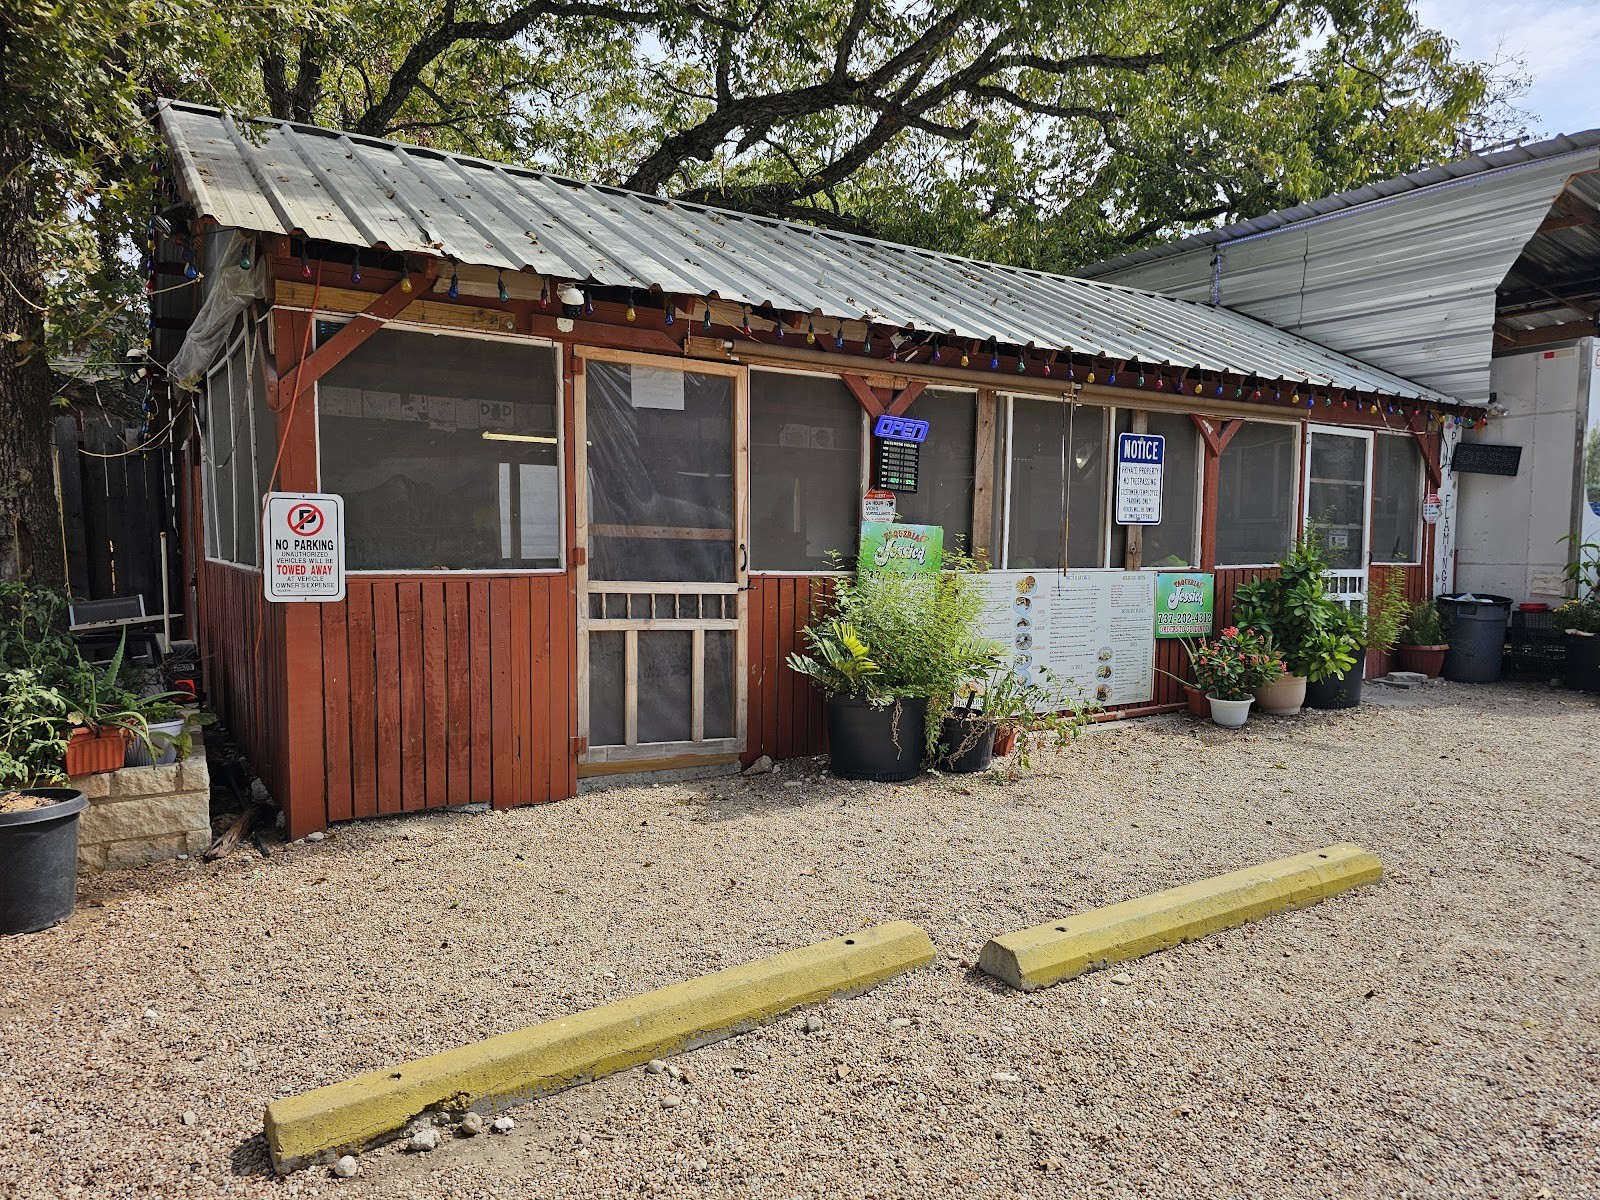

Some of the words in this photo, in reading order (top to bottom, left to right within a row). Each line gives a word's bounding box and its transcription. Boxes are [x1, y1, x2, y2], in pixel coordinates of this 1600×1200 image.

[881, 419, 923, 440] OPEN
[1123, 439, 1159, 460] NOTICE
[1121, 466, 1138, 475] PRIVATE
[1139, 466, 1160, 476] PROPERTY
[1123, 477, 1130, 485] NO
[1130, 477, 1157, 486] TRESPASSING
[1126, 497, 1142, 505] PARKING
[275, 539, 289, 551] NO
[294, 539, 334, 551] PARKING
[1441, 494, 1451, 594] FLAMINGO
[873, 539, 927, 568] Jessica
[276, 564, 306, 575] TOWED
[310, 565, 333, 576] AWAY
[1167, 586, 1205, 610] Jessica
[1158, 613, 1212, 625] 737-202-4312
